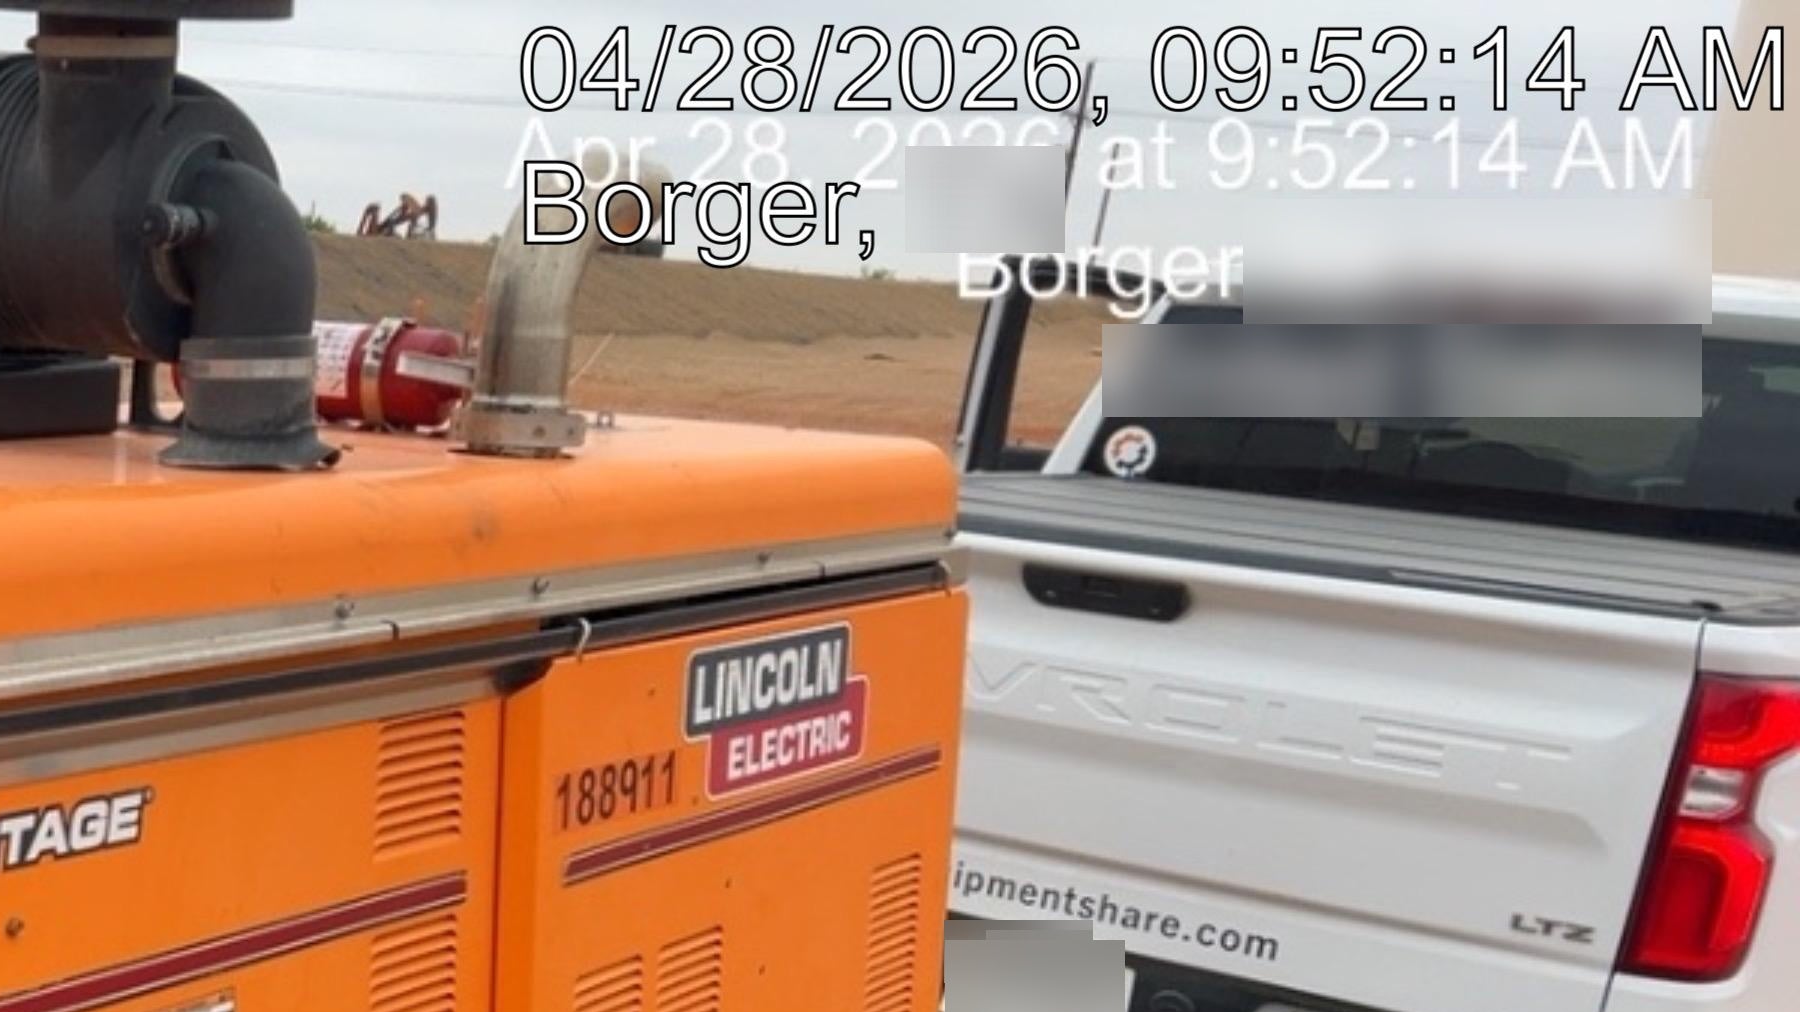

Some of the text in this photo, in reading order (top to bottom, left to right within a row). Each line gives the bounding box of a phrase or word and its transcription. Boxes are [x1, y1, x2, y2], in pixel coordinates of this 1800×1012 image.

[693, 638, 842, 726] LINCOLN
[728, 709, 852, 782] ELECTRIC
[556, 750, 677, 830] 188911
[953, 861, 1280, 961] ipmentshare.com
[1510, 914, 1596, 944] LTZ
